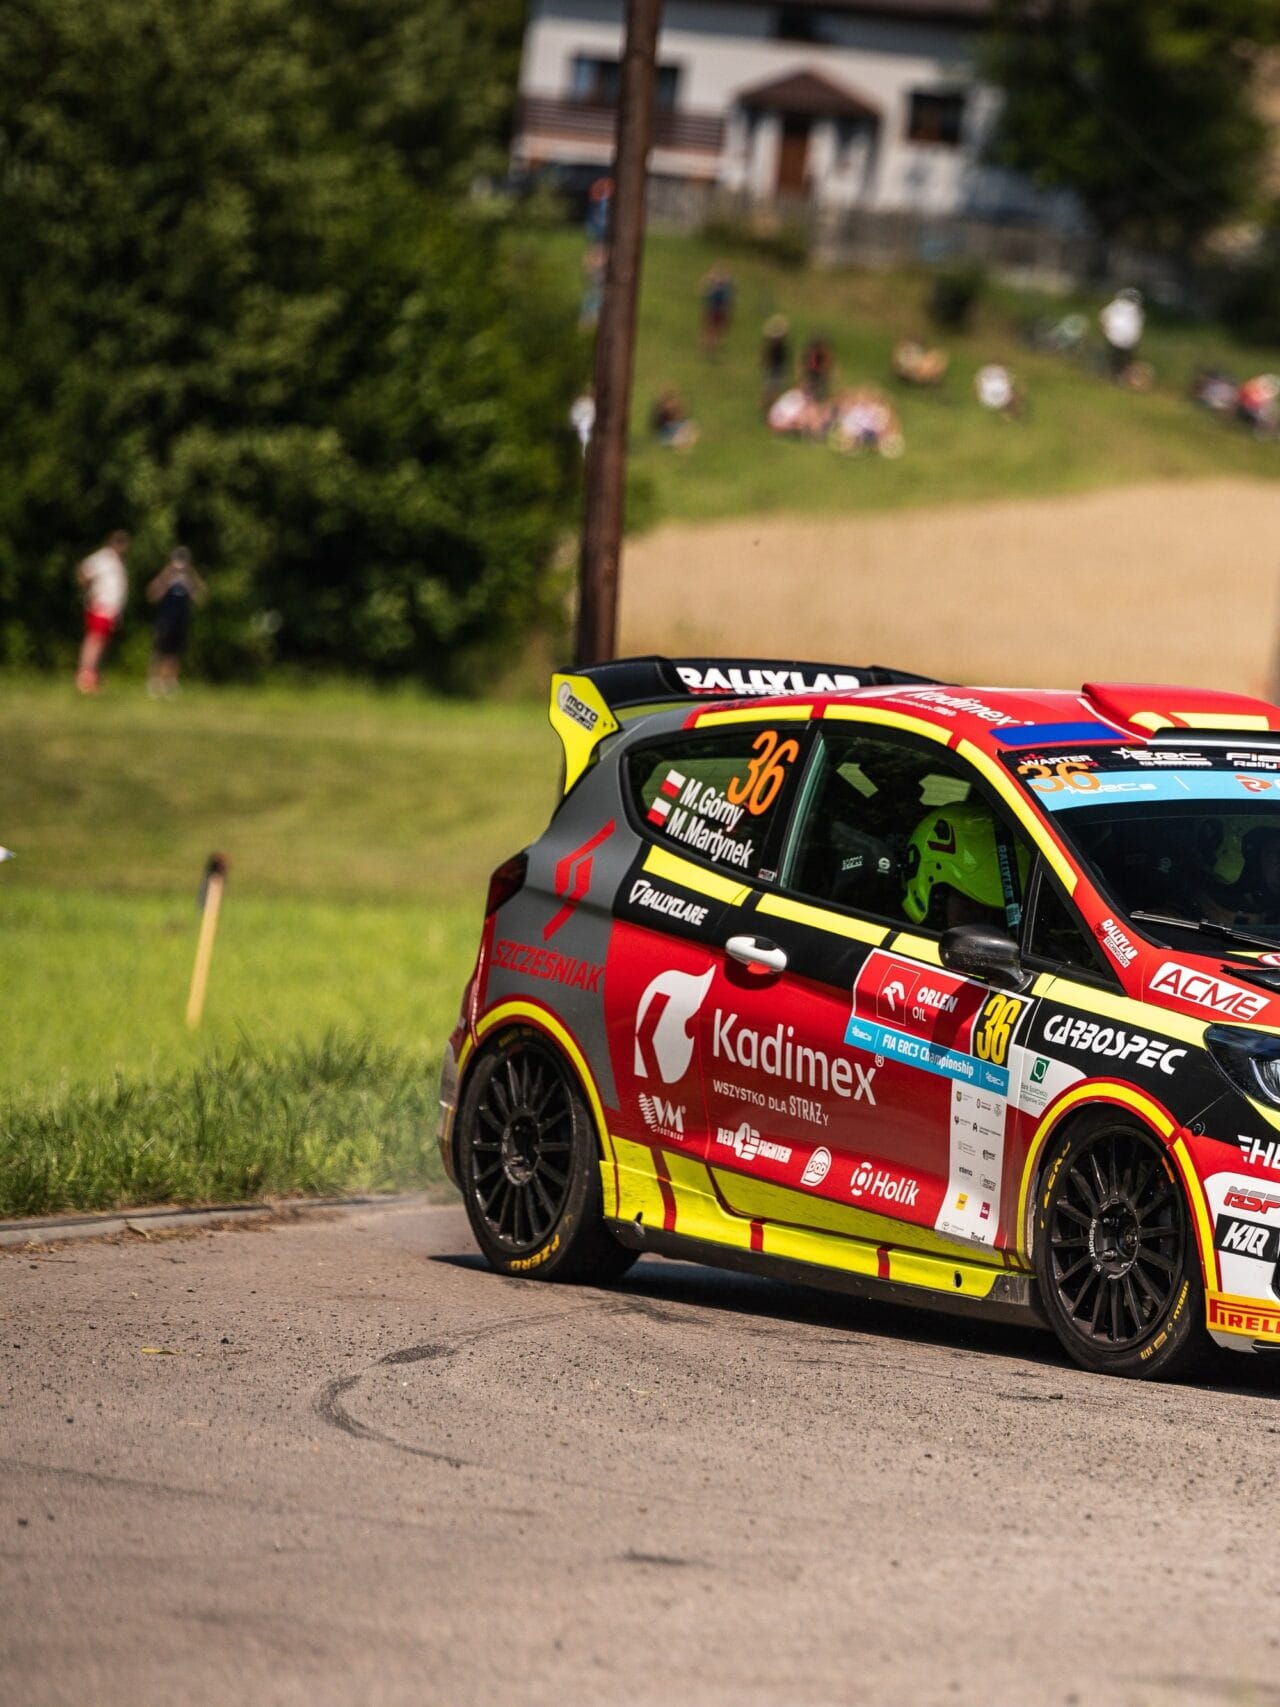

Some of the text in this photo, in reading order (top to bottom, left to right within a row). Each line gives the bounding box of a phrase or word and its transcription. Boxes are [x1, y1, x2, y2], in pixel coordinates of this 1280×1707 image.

[727, 730, 800, 816] 36
[1016, 762, 1101, 793] 36
[1020, 754, 1094, 767] WARTER
[665, 808, 755, 869] M.Martynek
[640, 884, 709, 926] BALLYCLARE
[1101, 918, 1139, 960] RALLYLAB
[912, 1006, 927, 1022] OIL
[916, 986, 960, 1014] ORLEN
[1153, 969, 1258, 1019] ACME
[976, 993, 1023, 1065] 36
[1043, 1014, 1188, 1075] CARBOSPEC
[712, 1008, 877, 1106] Kadimex
[882, 1034, 974, 1079] FIA ERC3 Championship
[652, 1095, 685, 1133] VM
[713, 1080, 766, 1107] WSZYSTKO
[768, 1096, 787, 1114] DLA
[716, 1127, 793, 1164] RED FIGHTER
